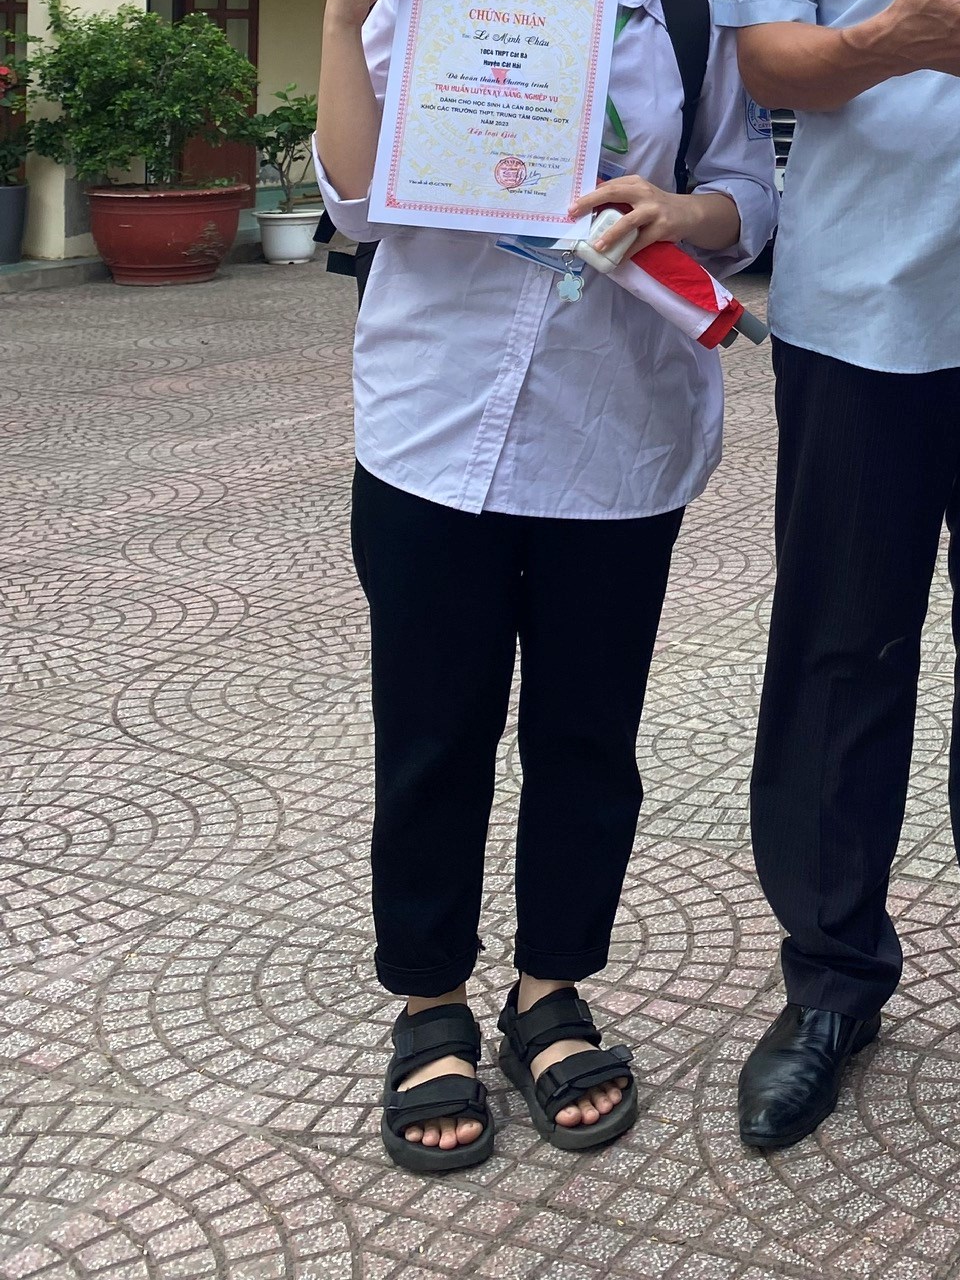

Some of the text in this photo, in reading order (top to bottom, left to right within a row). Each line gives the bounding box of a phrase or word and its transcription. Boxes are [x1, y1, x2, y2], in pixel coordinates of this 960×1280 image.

[469, 8, 546, 28] CHỨNG NHẬN
[492, 33, 520, 44] Minh
[435, 84, 450, 92] TRẠI
[450, 84, 469, 93] HUẤN
